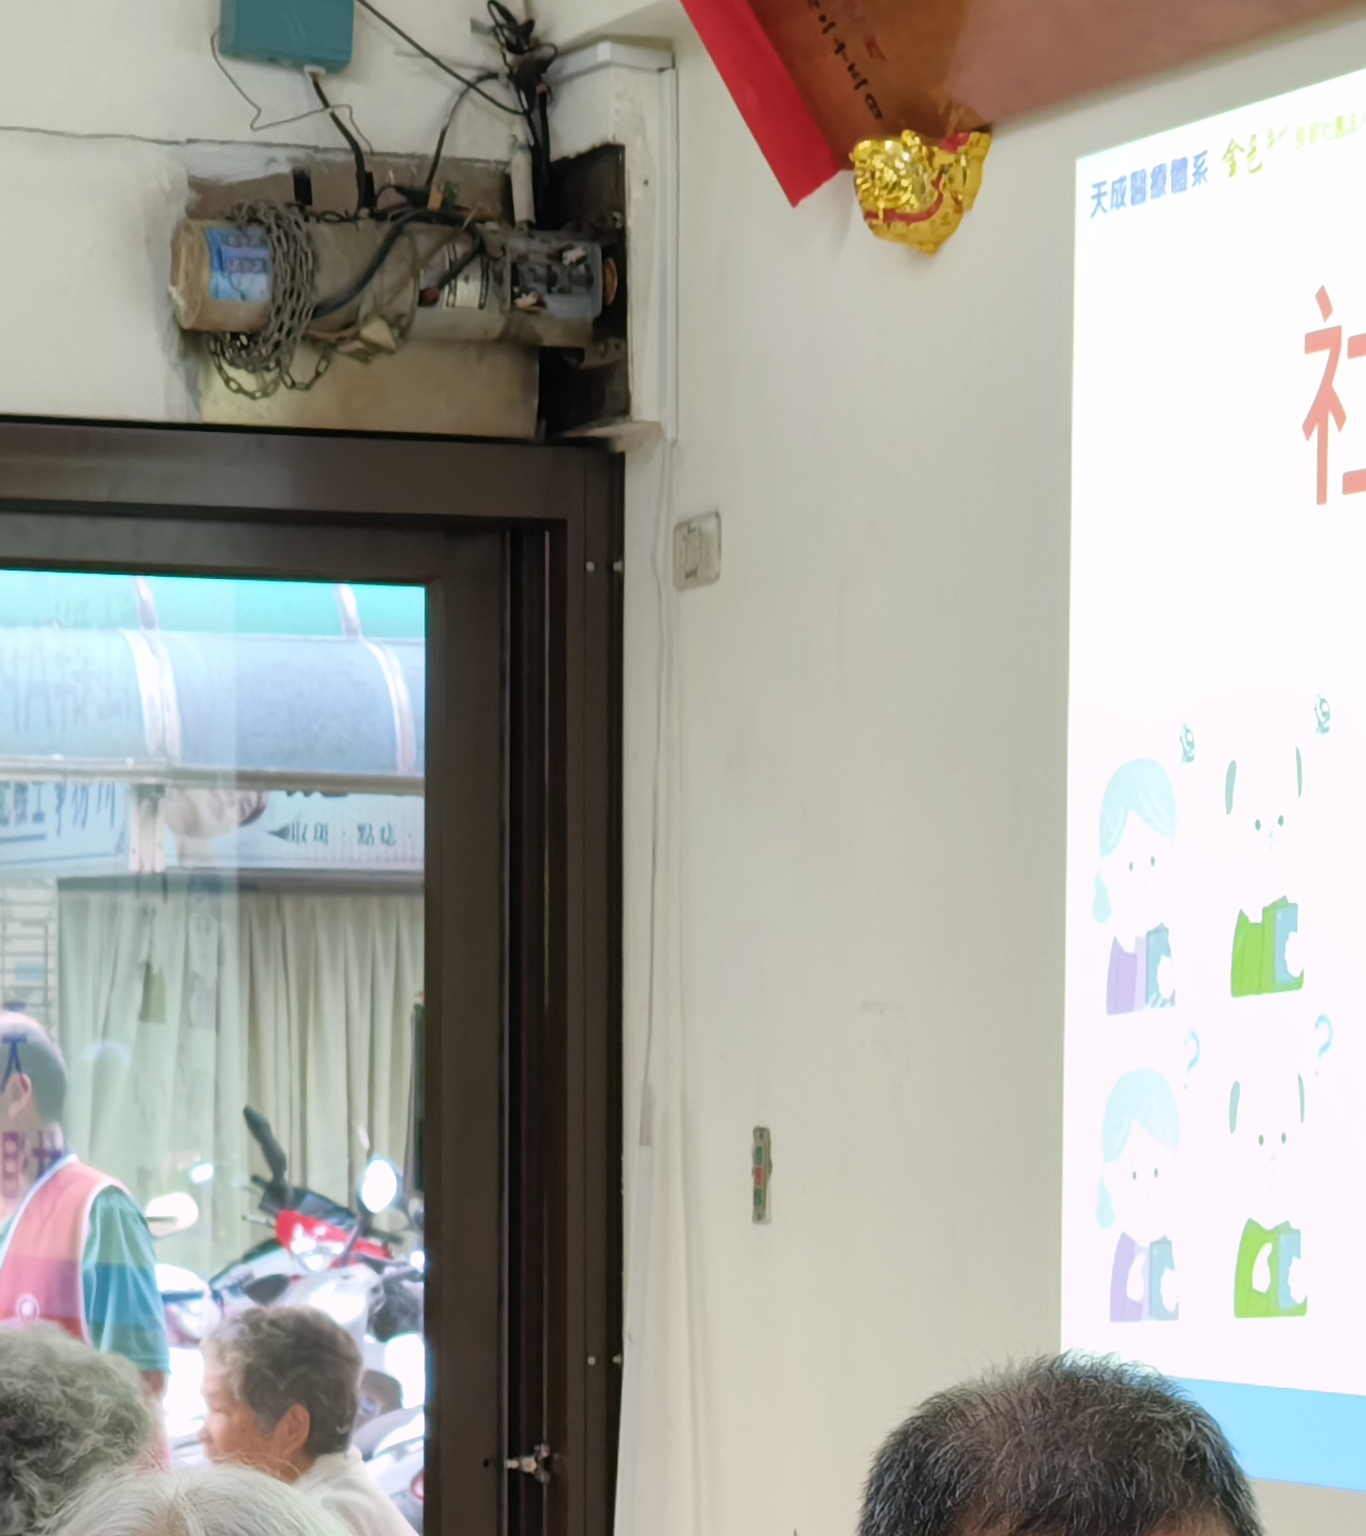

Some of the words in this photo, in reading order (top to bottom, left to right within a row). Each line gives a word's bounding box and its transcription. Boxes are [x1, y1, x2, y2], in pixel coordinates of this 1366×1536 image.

[1090, 150, 1209, 218] 天成醫療體系
